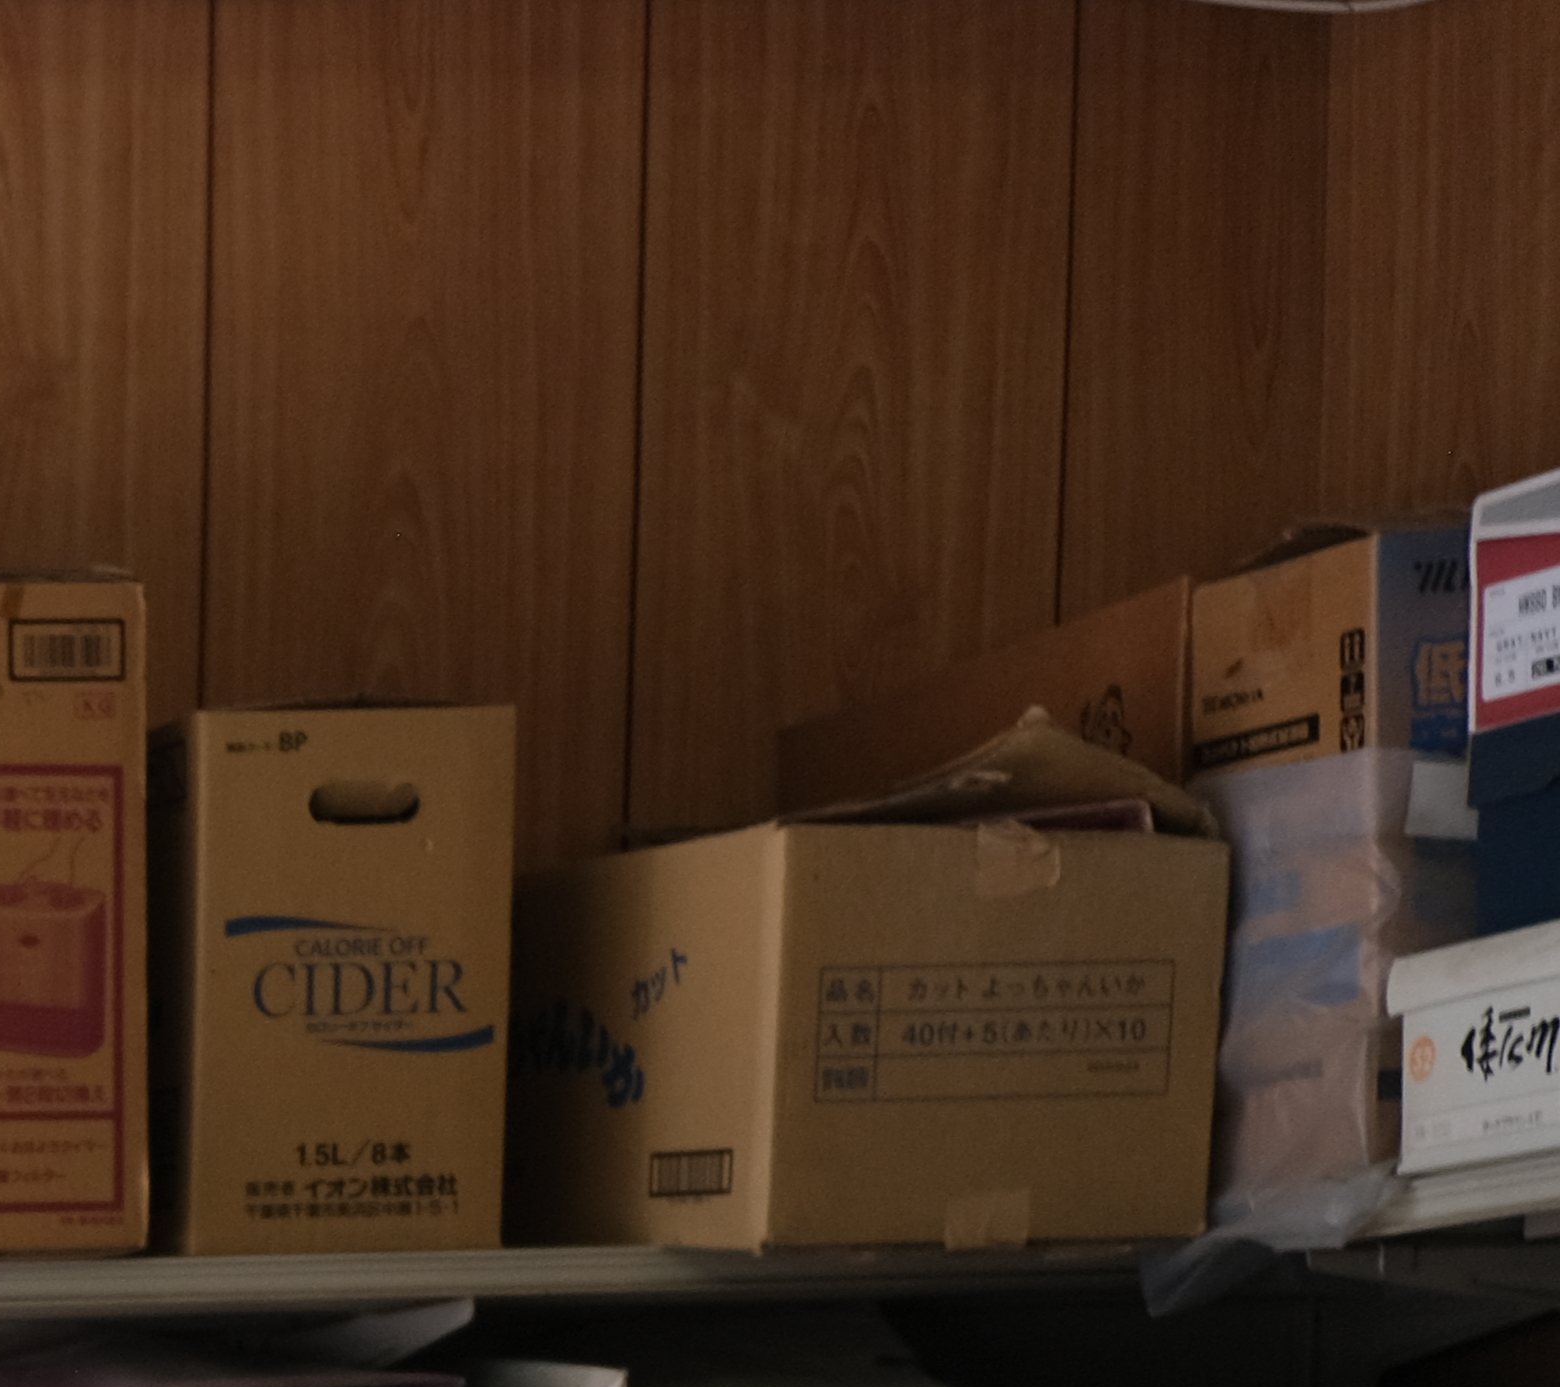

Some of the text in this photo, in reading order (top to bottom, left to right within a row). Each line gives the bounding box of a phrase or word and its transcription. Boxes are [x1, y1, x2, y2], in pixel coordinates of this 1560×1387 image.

[294, 935, 430, 958] CALORIE OFF
[252, 957, 468, 1020] CIDER
[304, 1173, 458, 1198] イオン株式会社
